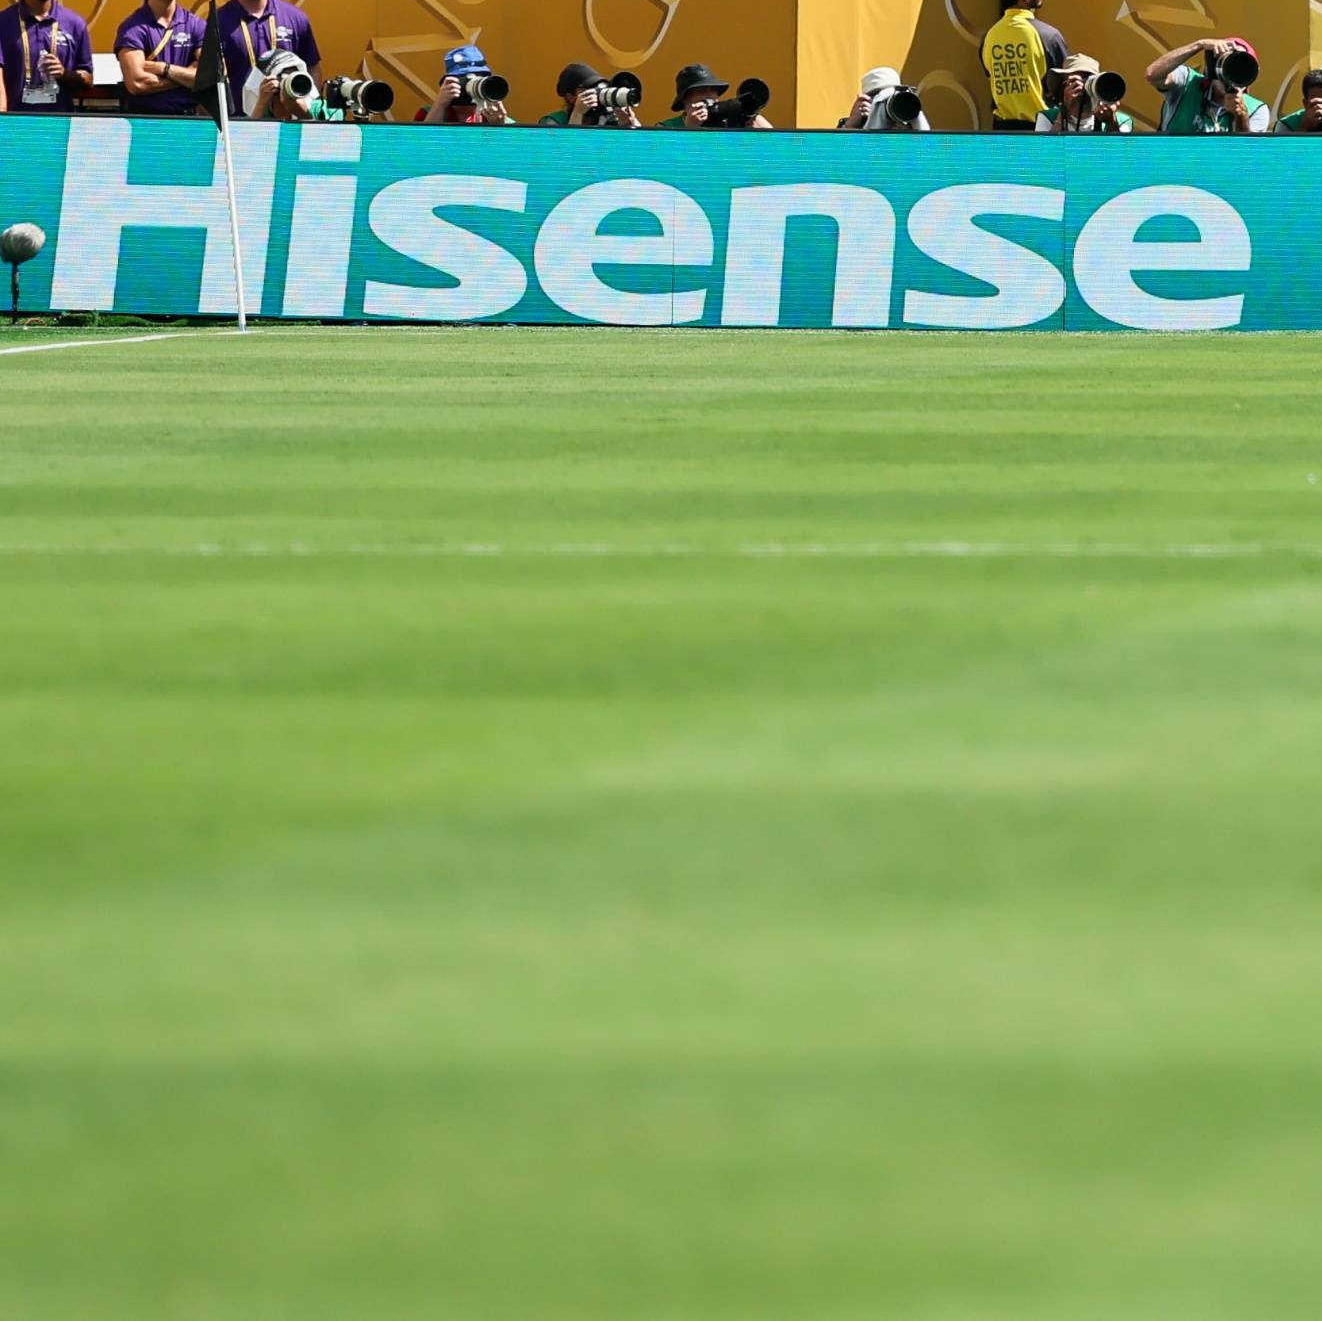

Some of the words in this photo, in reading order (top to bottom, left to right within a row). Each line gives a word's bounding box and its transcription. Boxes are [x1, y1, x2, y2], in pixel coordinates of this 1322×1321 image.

[992, 43, 1027, 60] CSC
[993, 61, 1027, 79] EVENT
[995, 79, 1029, 95] STAFF
[49, 117, 1252, 330] Hisense
